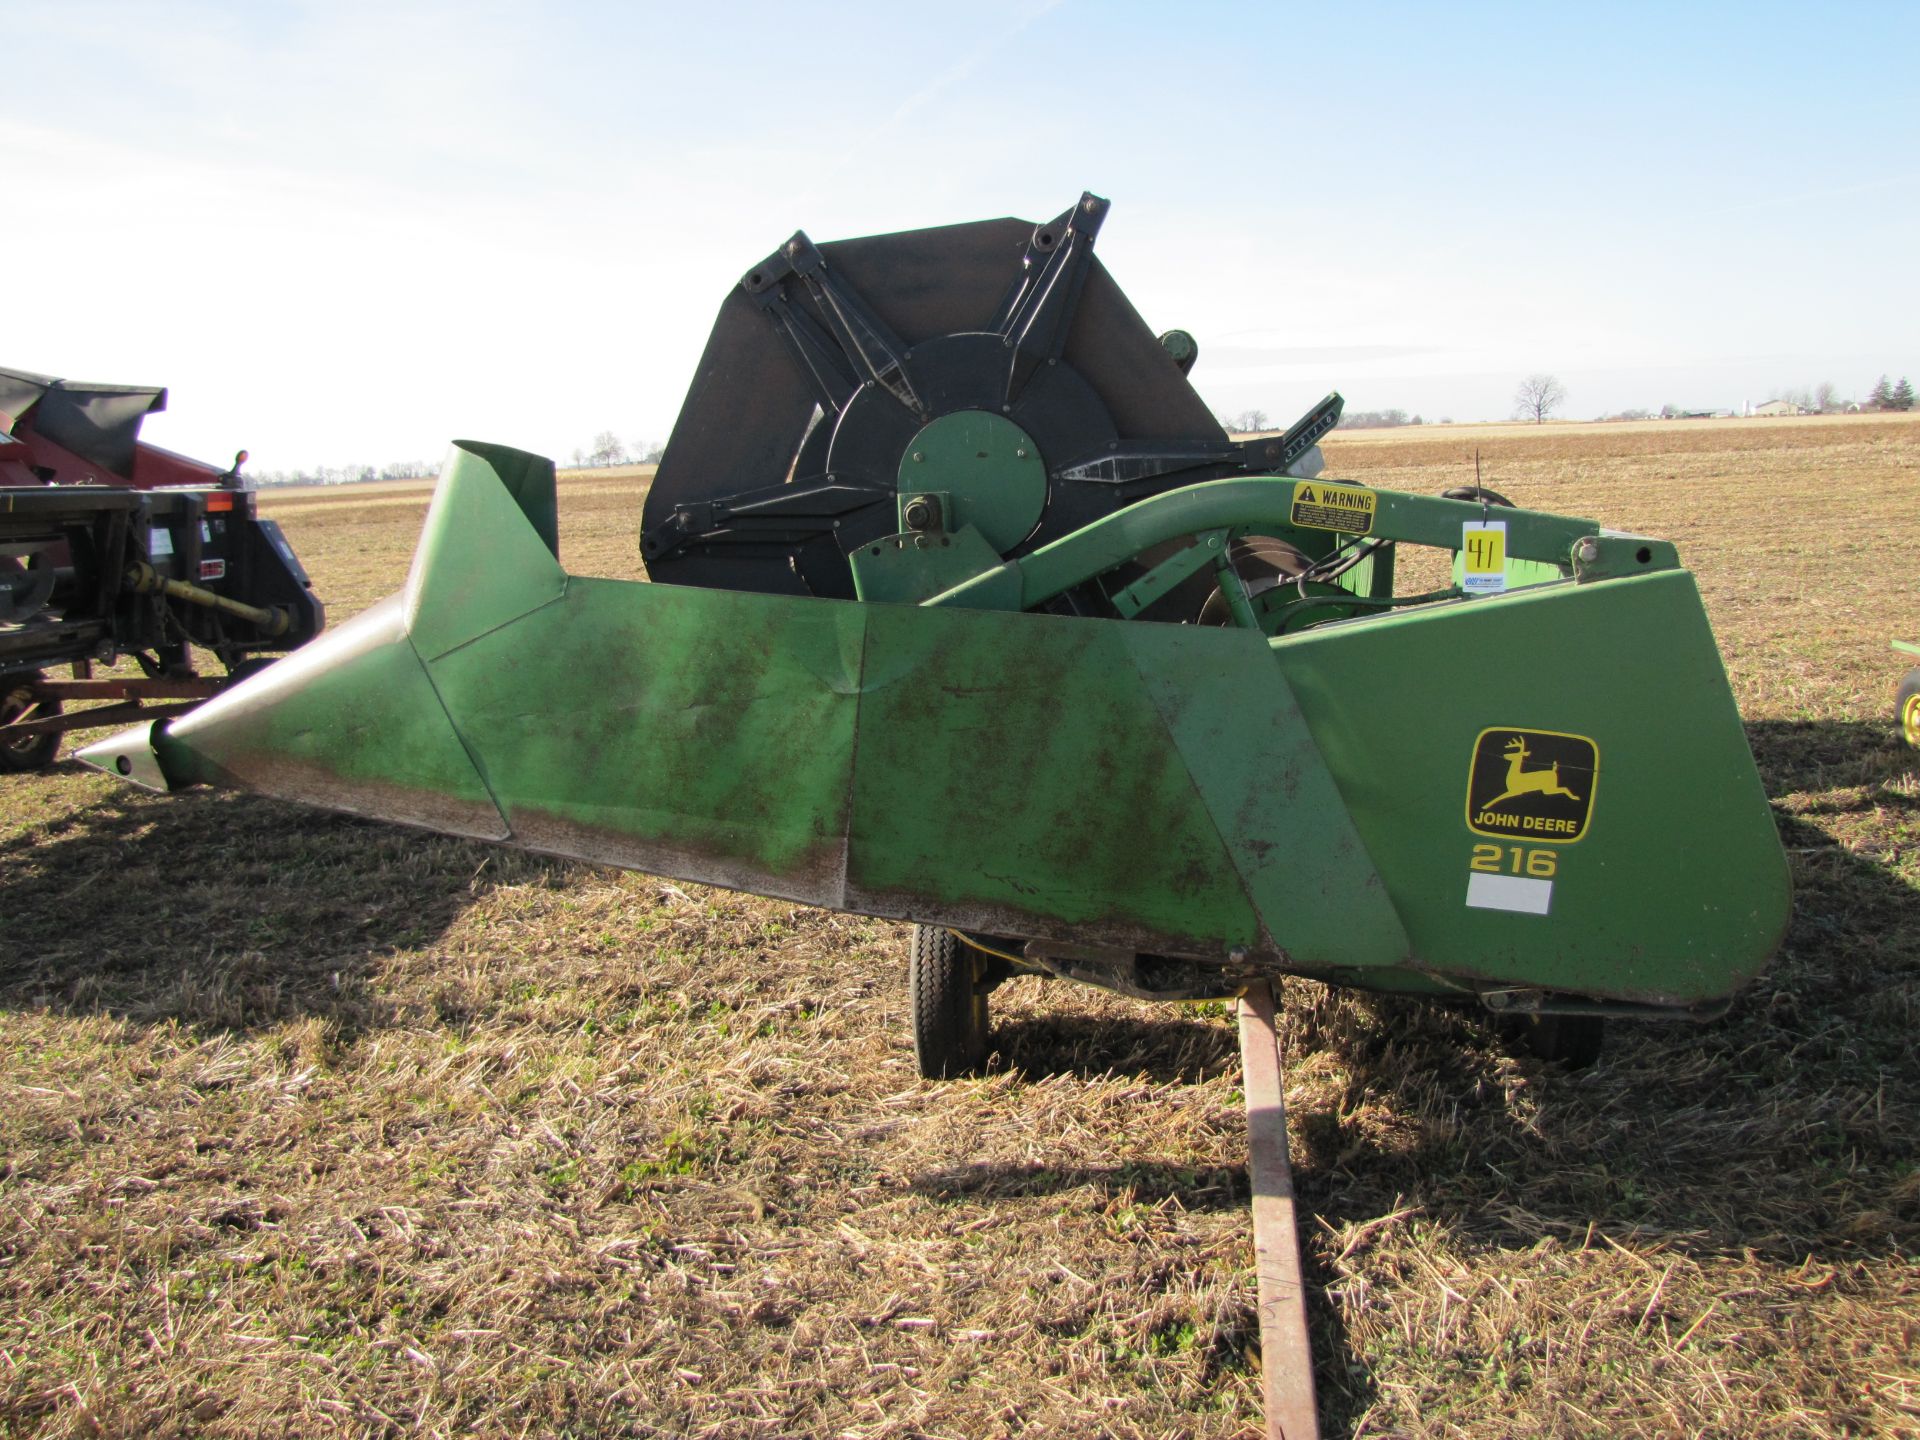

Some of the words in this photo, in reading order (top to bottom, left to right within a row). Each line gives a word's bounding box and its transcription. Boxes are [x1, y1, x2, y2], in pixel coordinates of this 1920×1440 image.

[1322, 489, 1372, 510] WARNING
[1468, 538, 1493, 569] 41
[1474, 812, 1519, 828] JOHN
[1522, 816, 1577, 833] DEERE
[1470, 844, 1557, 877] 216
